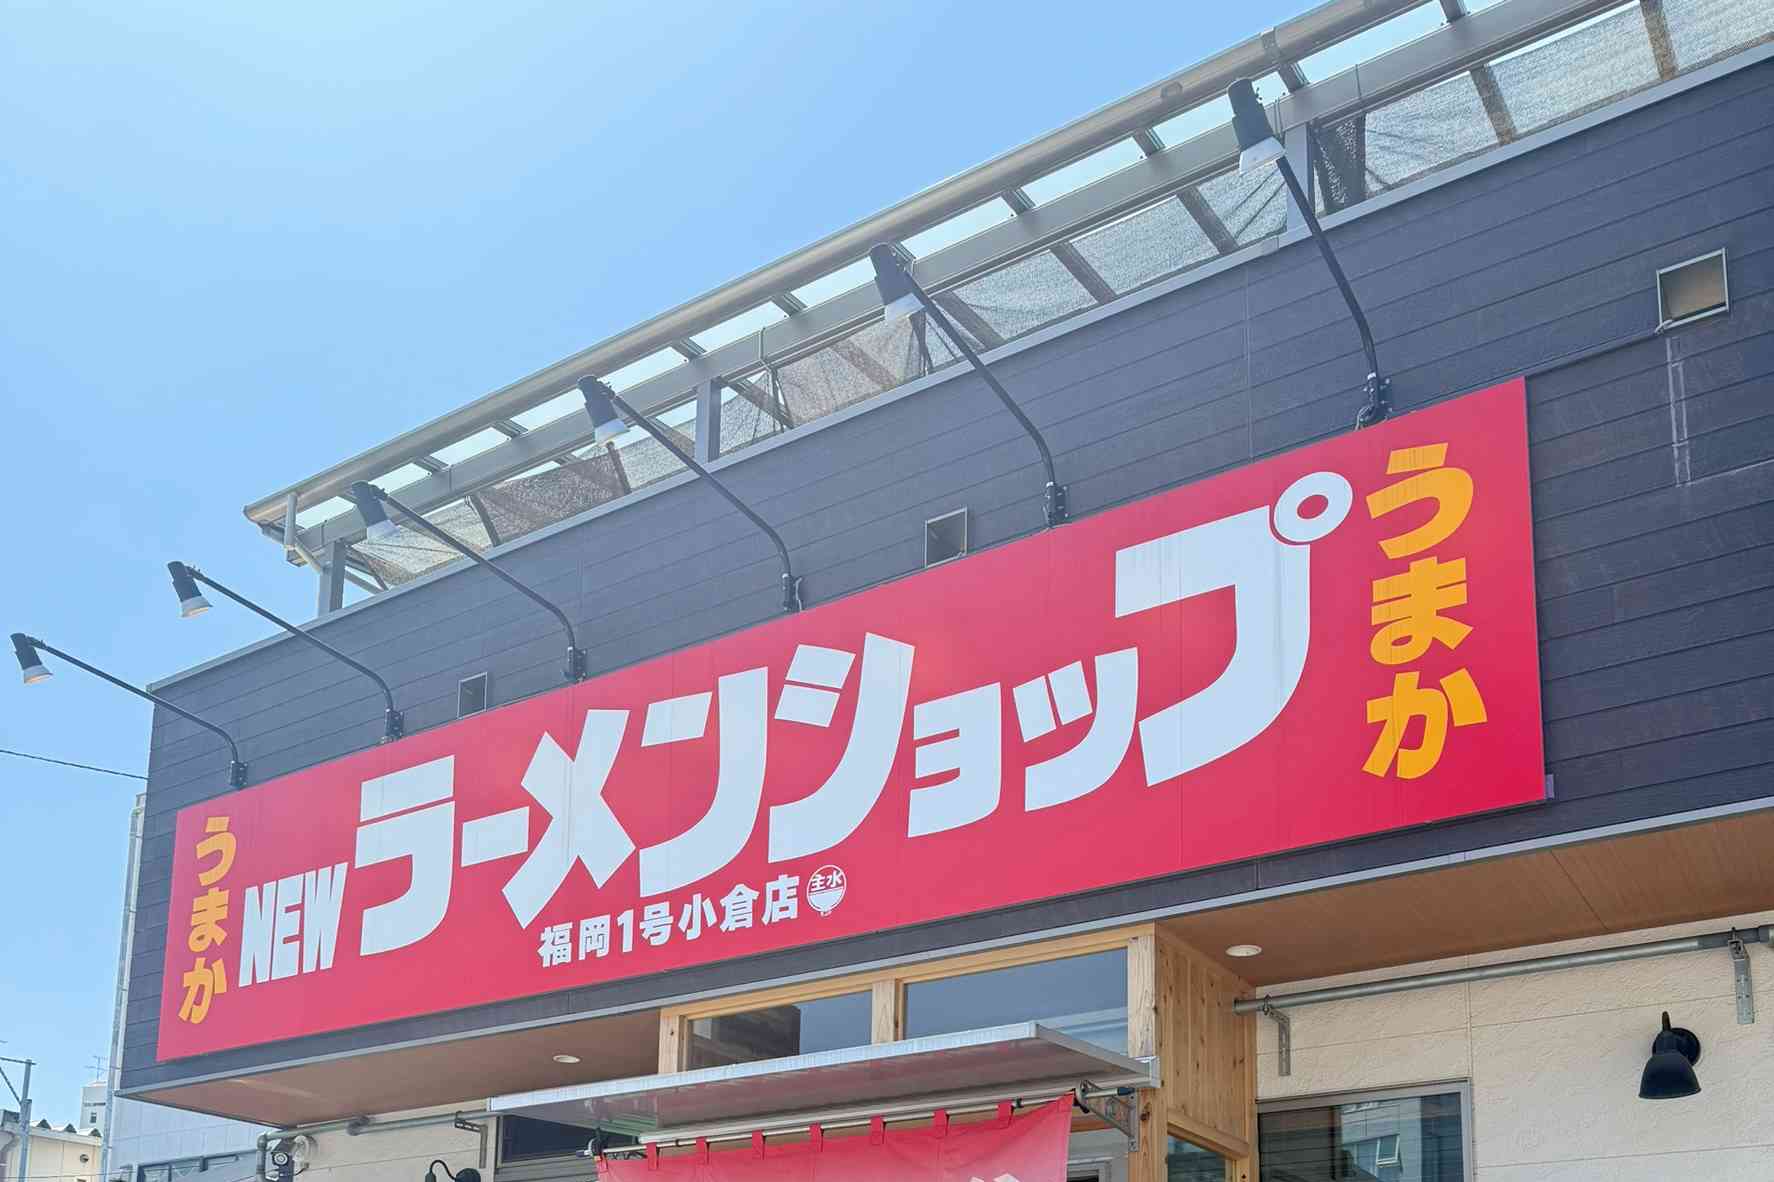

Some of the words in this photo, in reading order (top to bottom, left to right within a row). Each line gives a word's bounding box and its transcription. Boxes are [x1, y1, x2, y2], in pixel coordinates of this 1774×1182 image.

[239, 862, 349, 988] NEW
[354, 471, 1354, 957] ラーメンショップ
[1362, 442, 1488, 780] うまか
[178, 815, 237, 1024] うまか
[537, 873, 801, 968] 福岡1号小倉店
